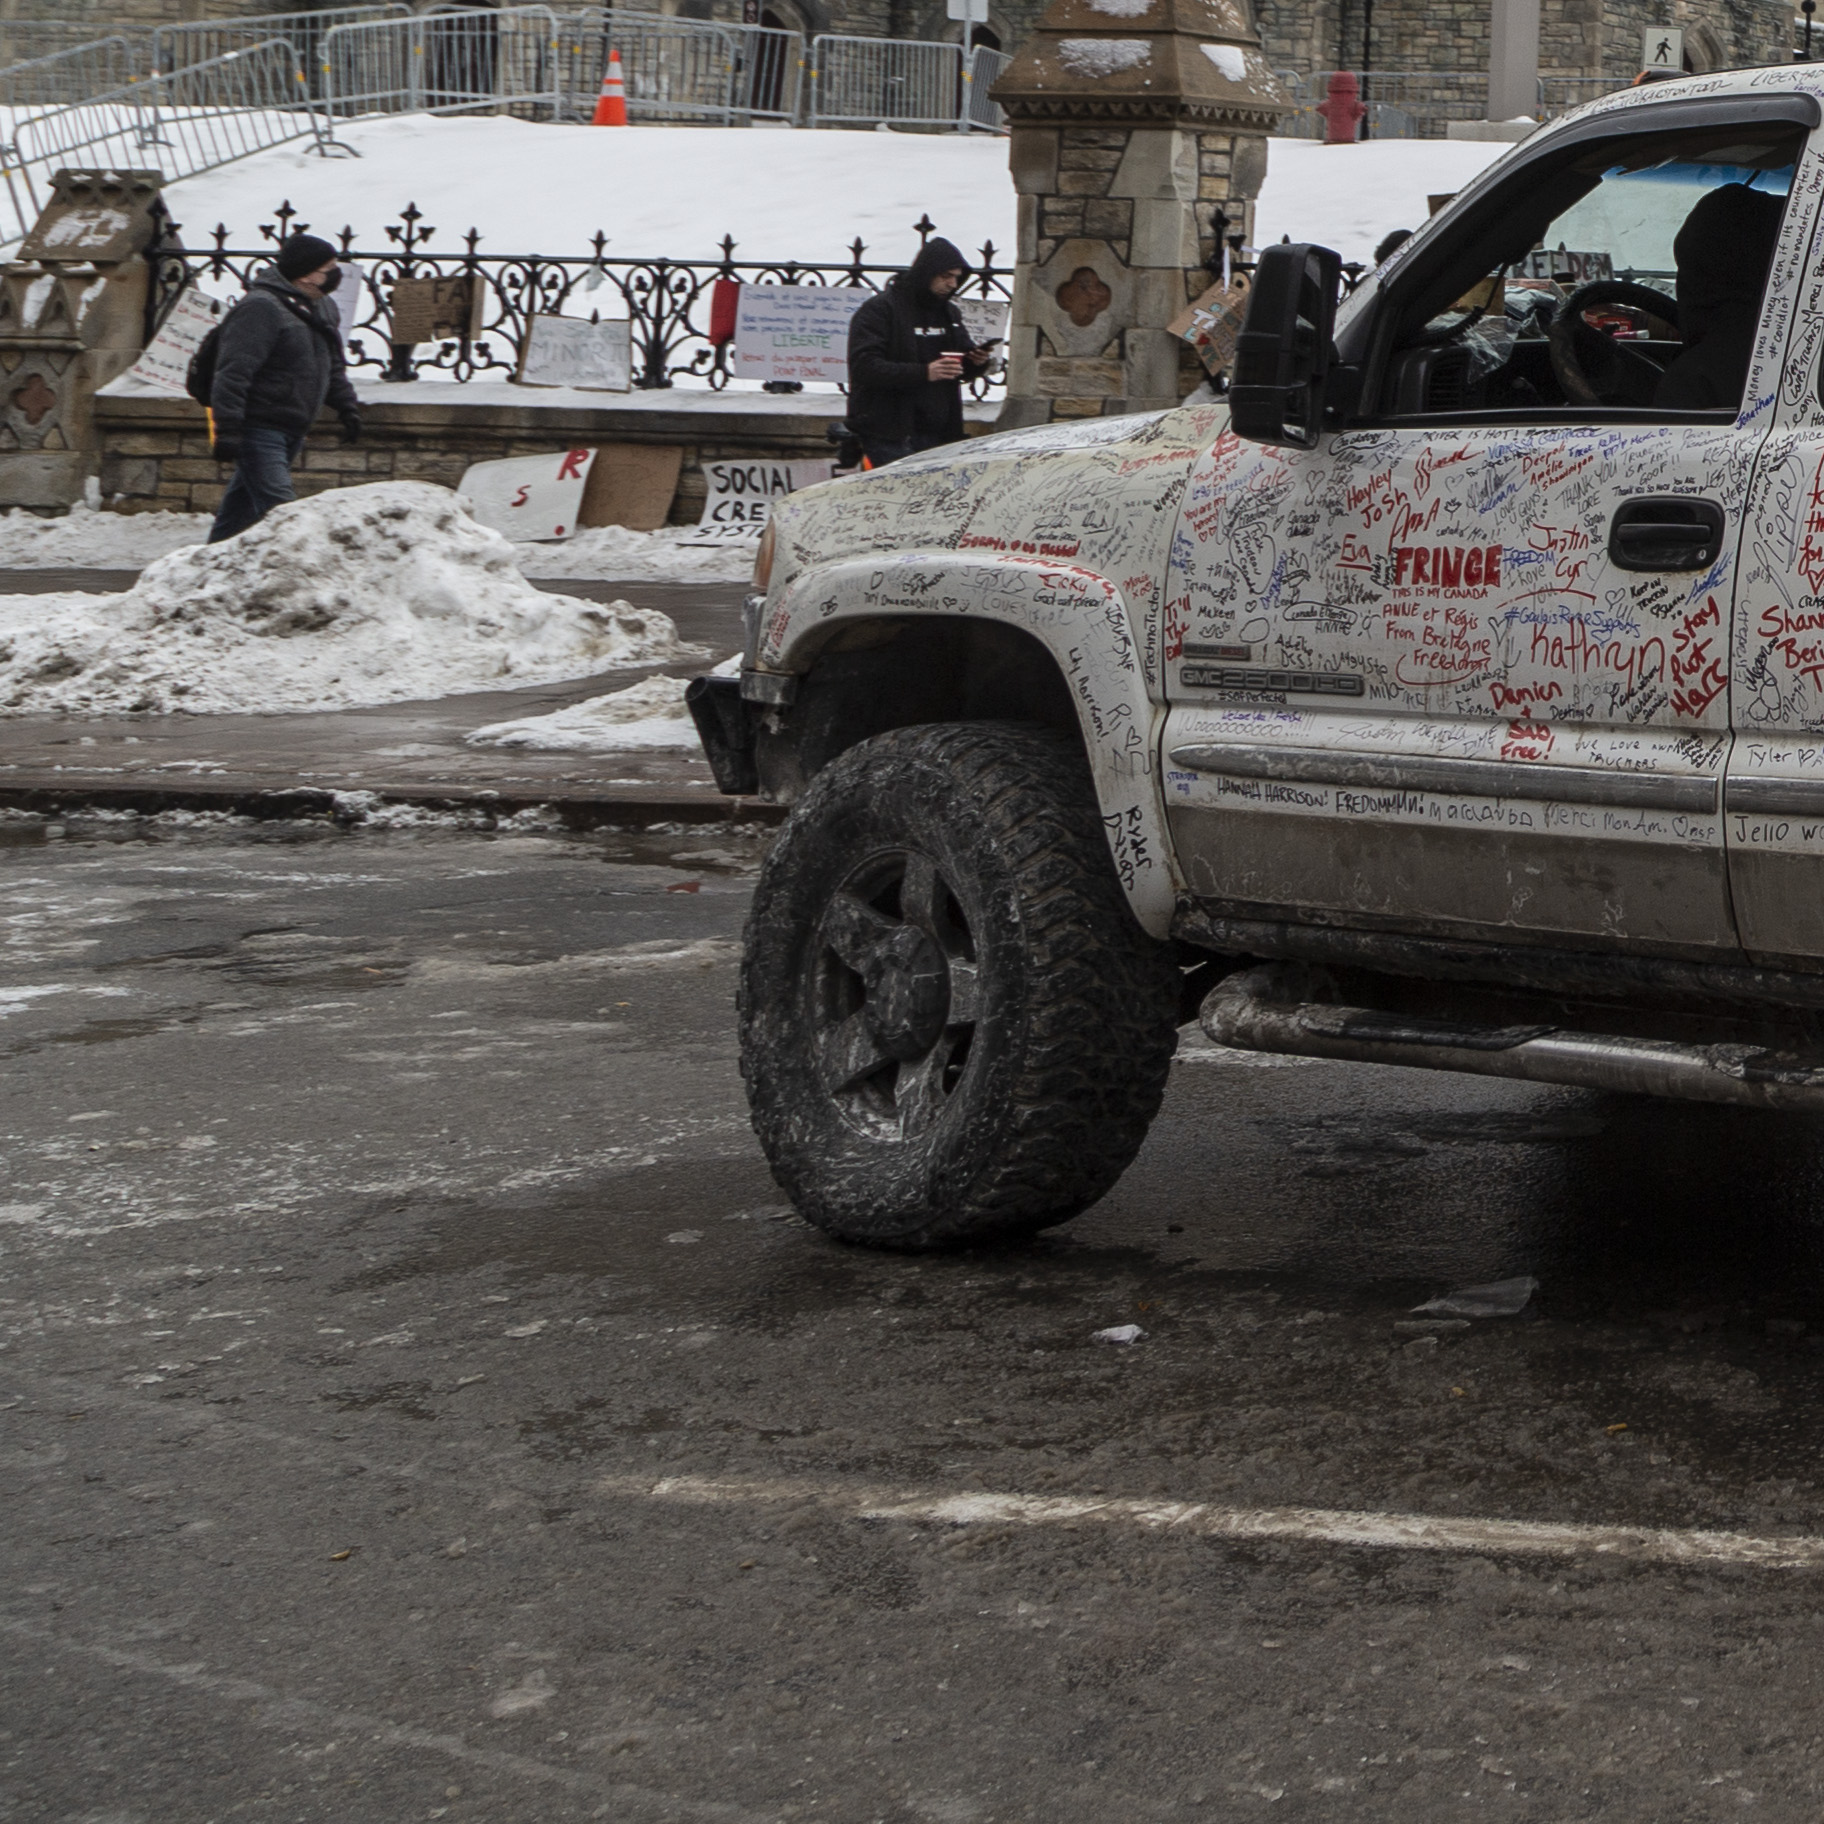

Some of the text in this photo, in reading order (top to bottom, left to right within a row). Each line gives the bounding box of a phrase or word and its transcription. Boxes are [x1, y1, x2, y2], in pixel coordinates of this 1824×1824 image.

[712, 466, 798, 495] SOCIAL
[1346, 470, 1394, 511] Hayley
[712, 501, 765, 522] CRE
[1341, 534, 1372, 564] Eva
[1394, 544, 1503, 588] FRINGE
[1391, 588, 1488, 600] THIS IS MY CANADA
[1382, 602, 1420, 619] ANNE
[1386, 625, 1415, 642] From
[1531, 623, 1666, 697] Kathryn
[1182, 670, 1222, 685] GMC
[1500, 734, 1556, 761] Free!
[1747, 744, 1791, 767] Tyler
[1733, 815, 1789, 844] Jello
